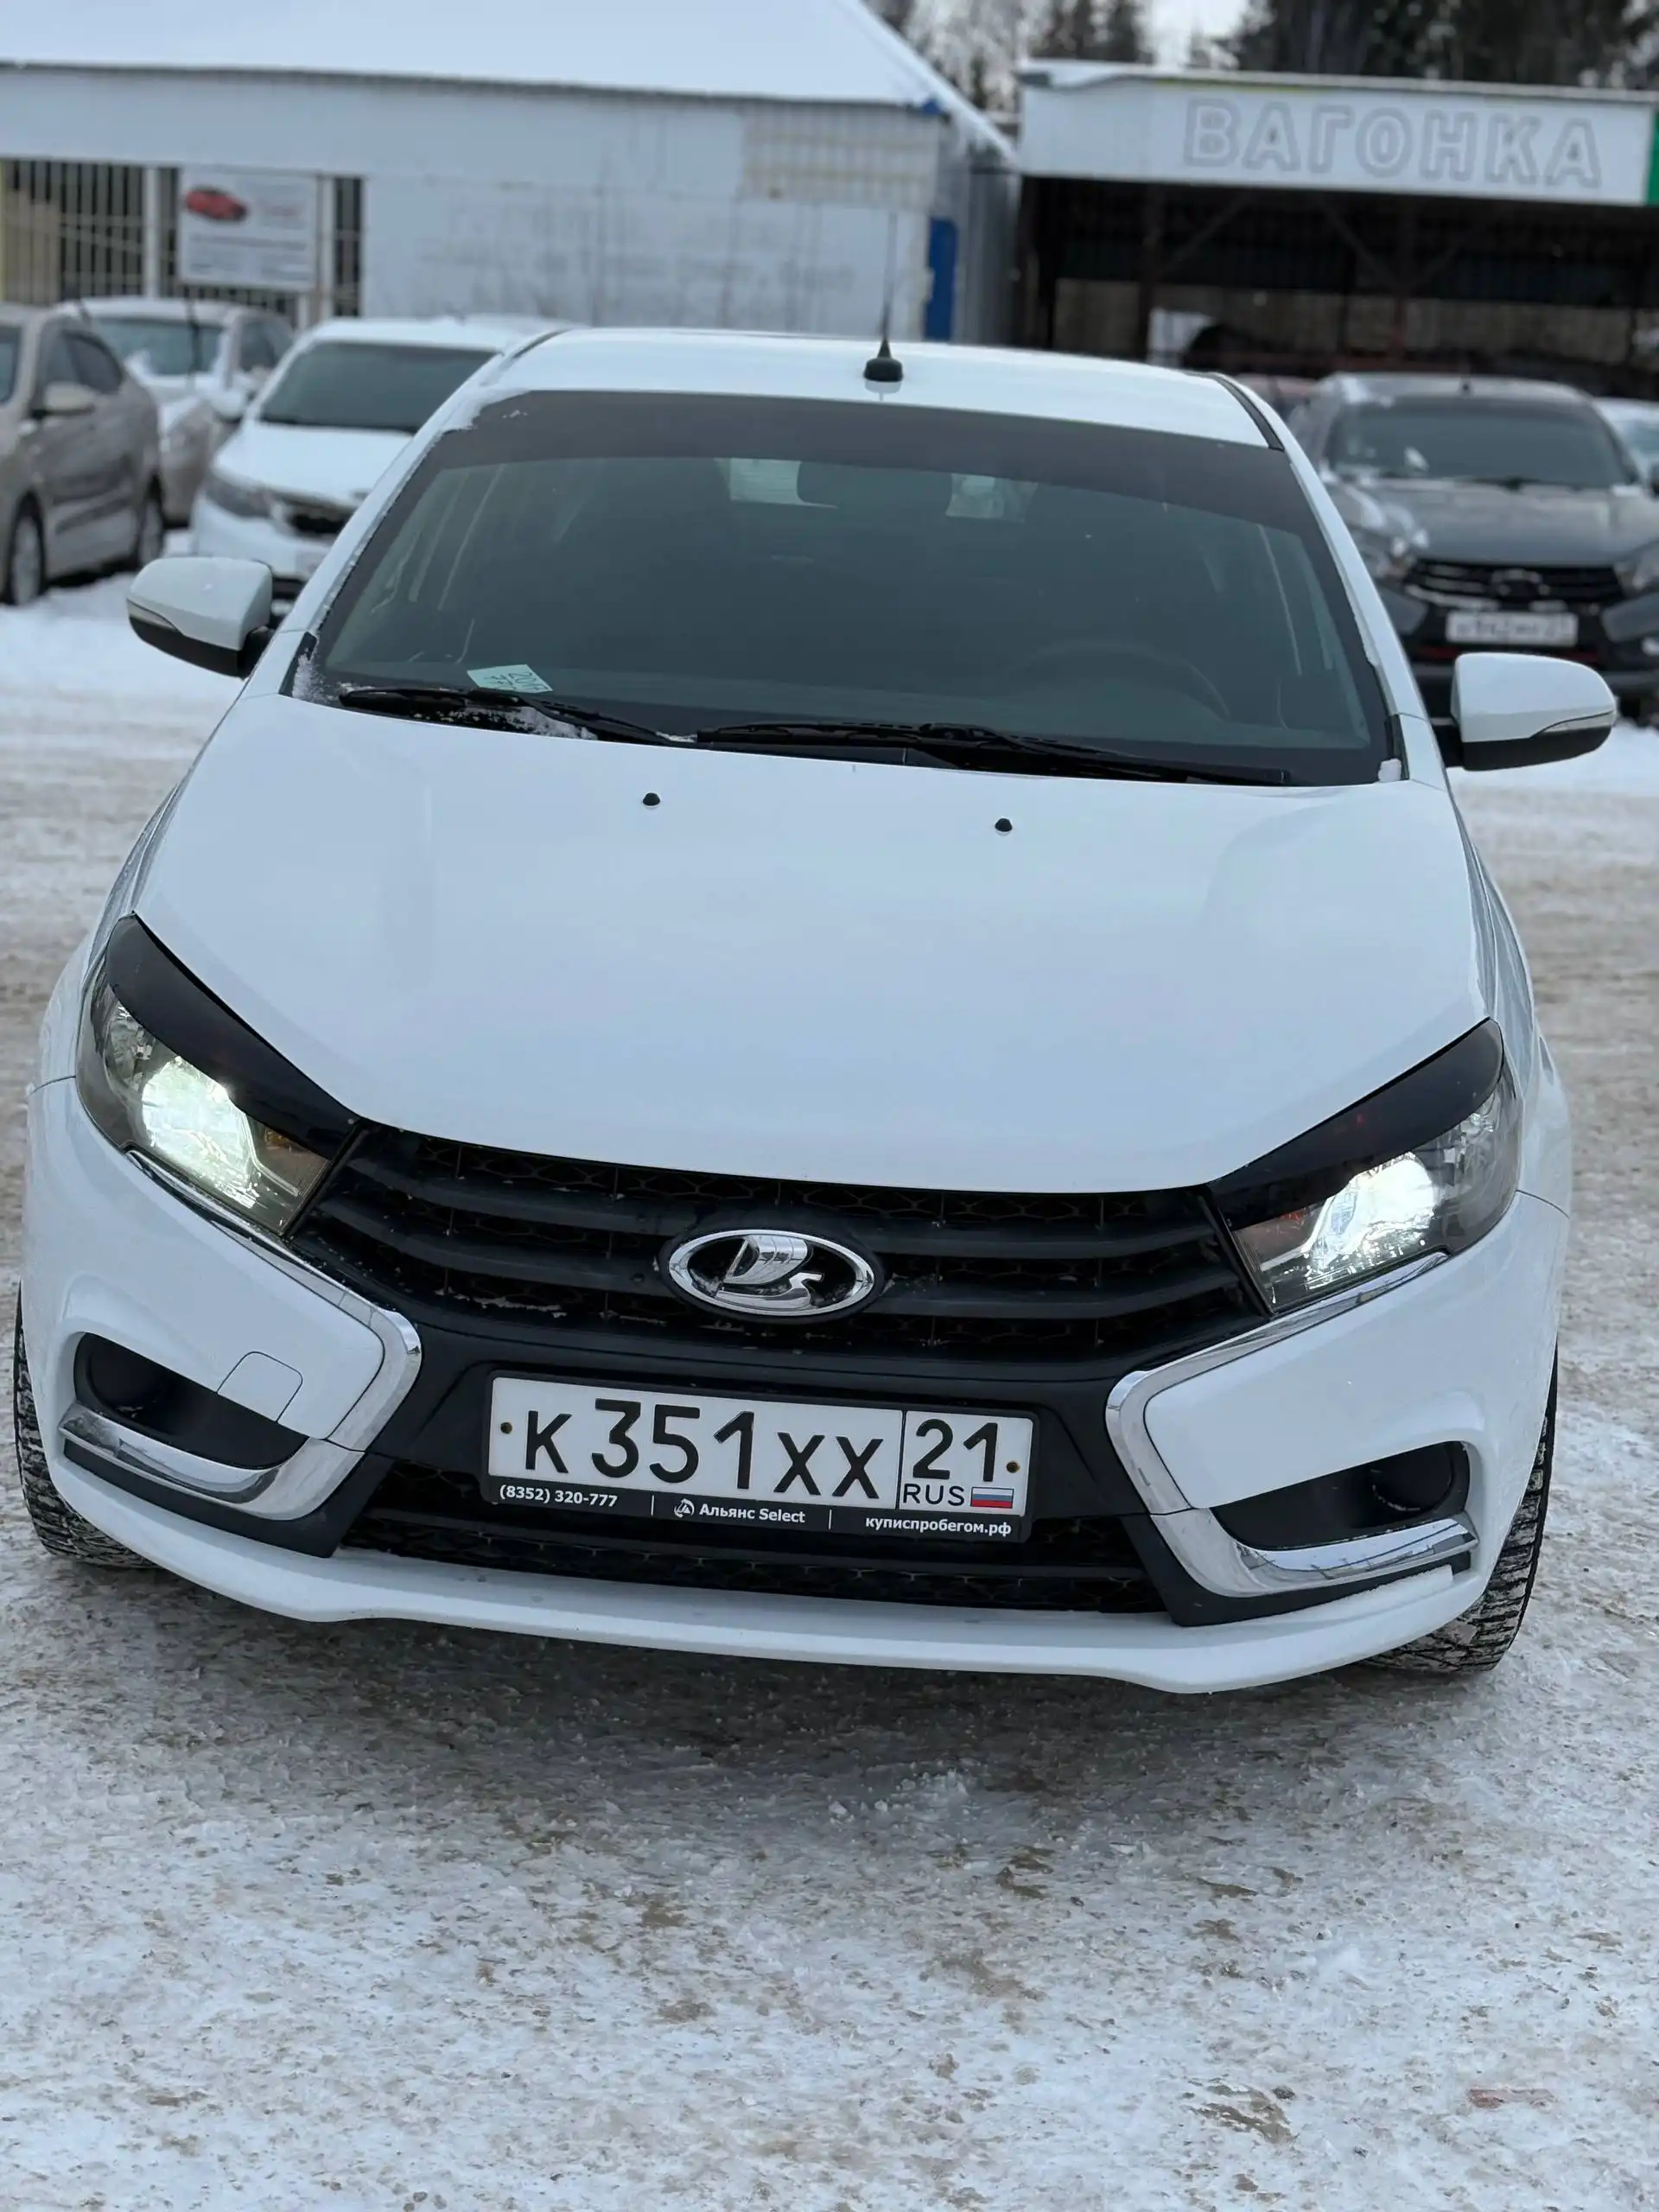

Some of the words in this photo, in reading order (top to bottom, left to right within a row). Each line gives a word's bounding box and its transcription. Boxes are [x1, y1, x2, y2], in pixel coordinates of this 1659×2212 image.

[1183, 97, 1604, 189] ВАГОНКА
[912, 1418, 1000, 1484] 21
[499, 1484, 551, 1504] (8352)
[554, 1490, 619, 1508] 320-777
[902, 1483, 966, 1507] RUS
[698, 1503, 756, 1521] Альянс
[759, 1507, 806, 1524] Select
[865, 1516, 1012, 1537] куписпробегом.рф
